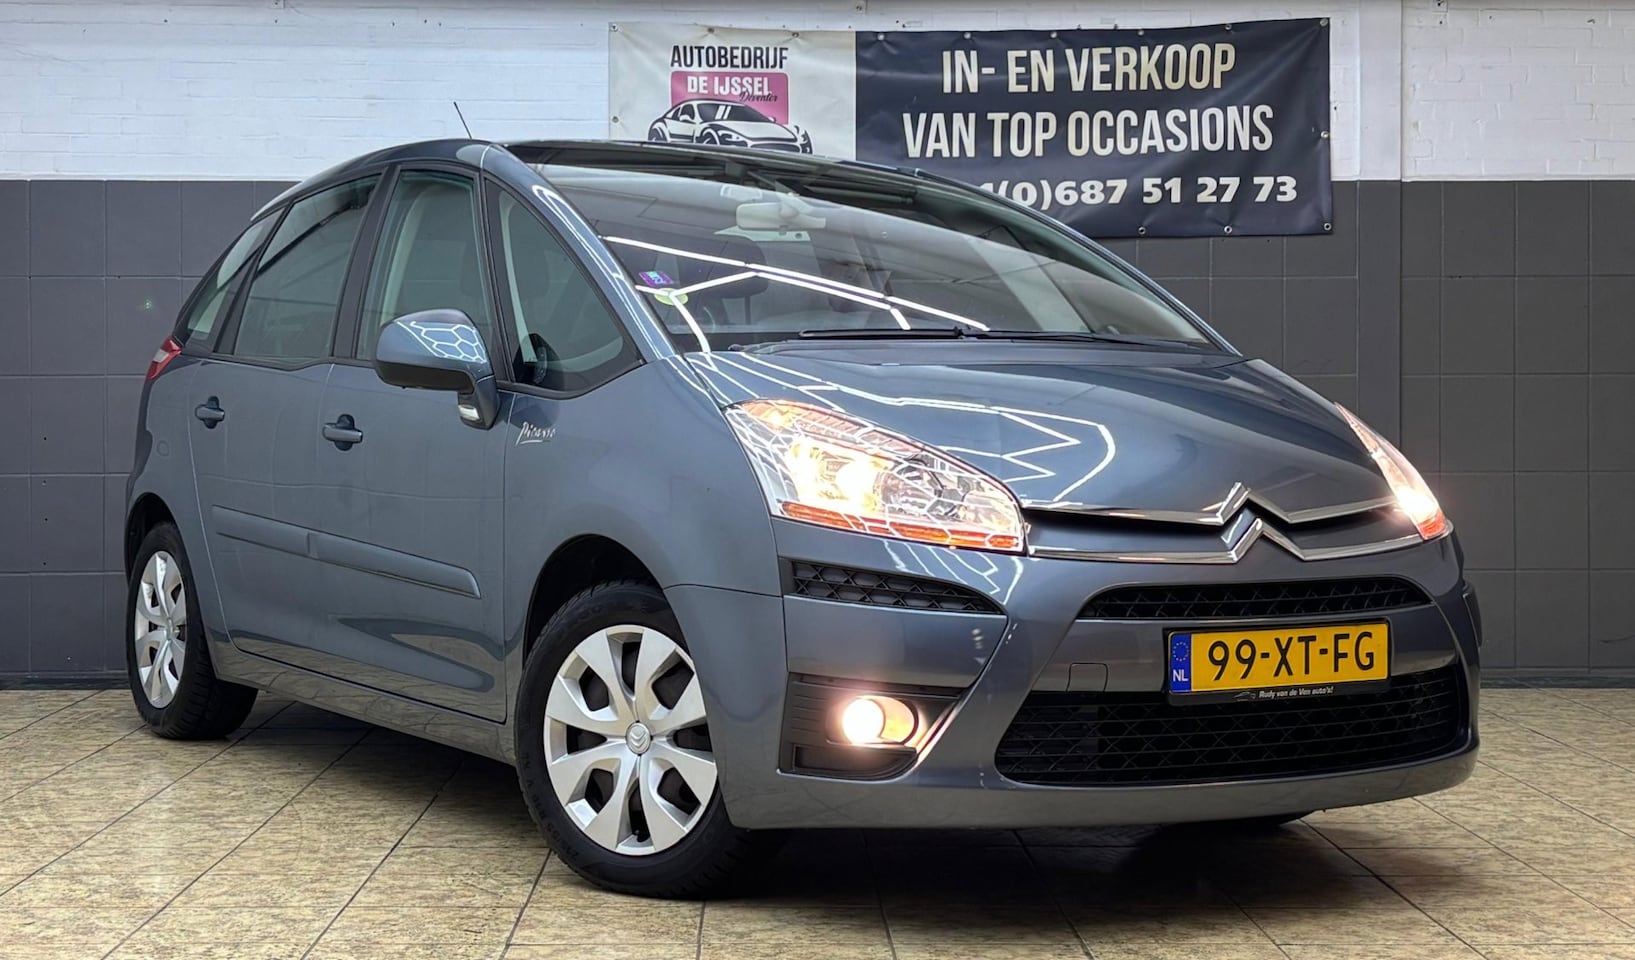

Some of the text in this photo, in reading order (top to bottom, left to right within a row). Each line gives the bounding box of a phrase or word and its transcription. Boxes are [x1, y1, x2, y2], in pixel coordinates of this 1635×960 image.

[670, 45, 789, 70] AUTOBEDRIJF
[942, 43, 1236, 93] IN- EN VERKOOP
[687, 75, 772, 96] DE IJSSEL
[739, 90, 778, 102] Deventer
[903, 104, 1274, 158] VAN TOP OCCASIONS
[1142, 176, 1182, 203] 51
[1197, 175, 1241, 202] 27
[1253, 175, 1298, 202] 73
[1208, 631, 1375, 681] 99-XT-FG
[1172, 669, 1189, 682] NL
[1289, 688, 1297, 696] de
